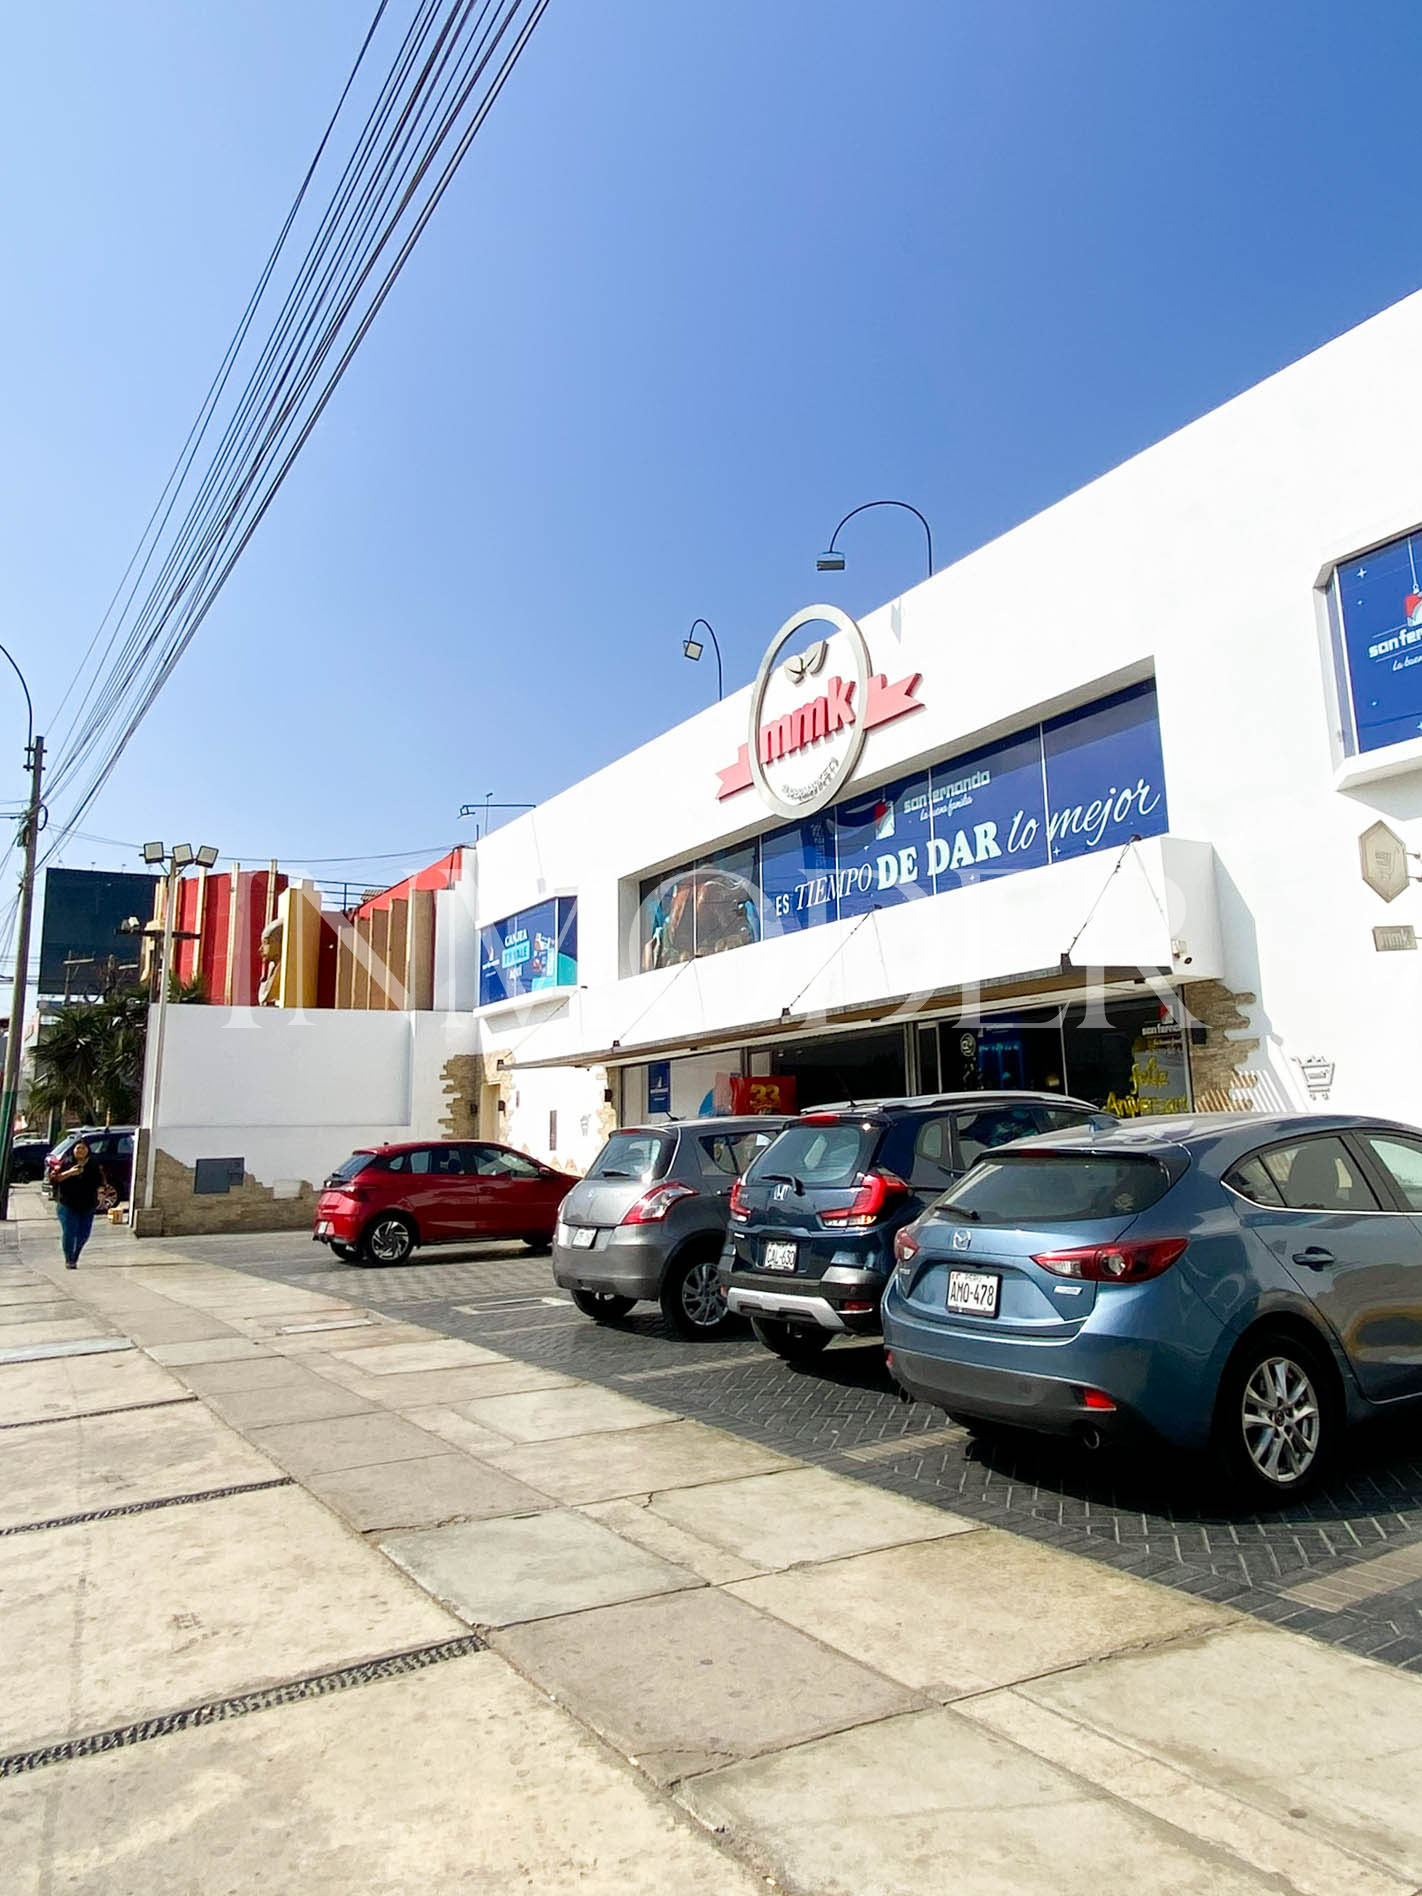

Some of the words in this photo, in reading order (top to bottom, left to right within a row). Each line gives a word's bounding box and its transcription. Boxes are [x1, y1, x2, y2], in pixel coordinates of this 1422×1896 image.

[760, 676, 855, 765] mmk
[903, 770, 991, 814] sanernando
[776, 895, 790, 917] ES
[795, 863, 873, 911] TIEMPO
[877, 846, 918, 891] DE
[926, 821, 1003, 877] DAR
[1007, 810, 1040, 853] lo
[1049, 779, 1161, 847] mejor
[950, 1280, 995, 1307] AMO-478
